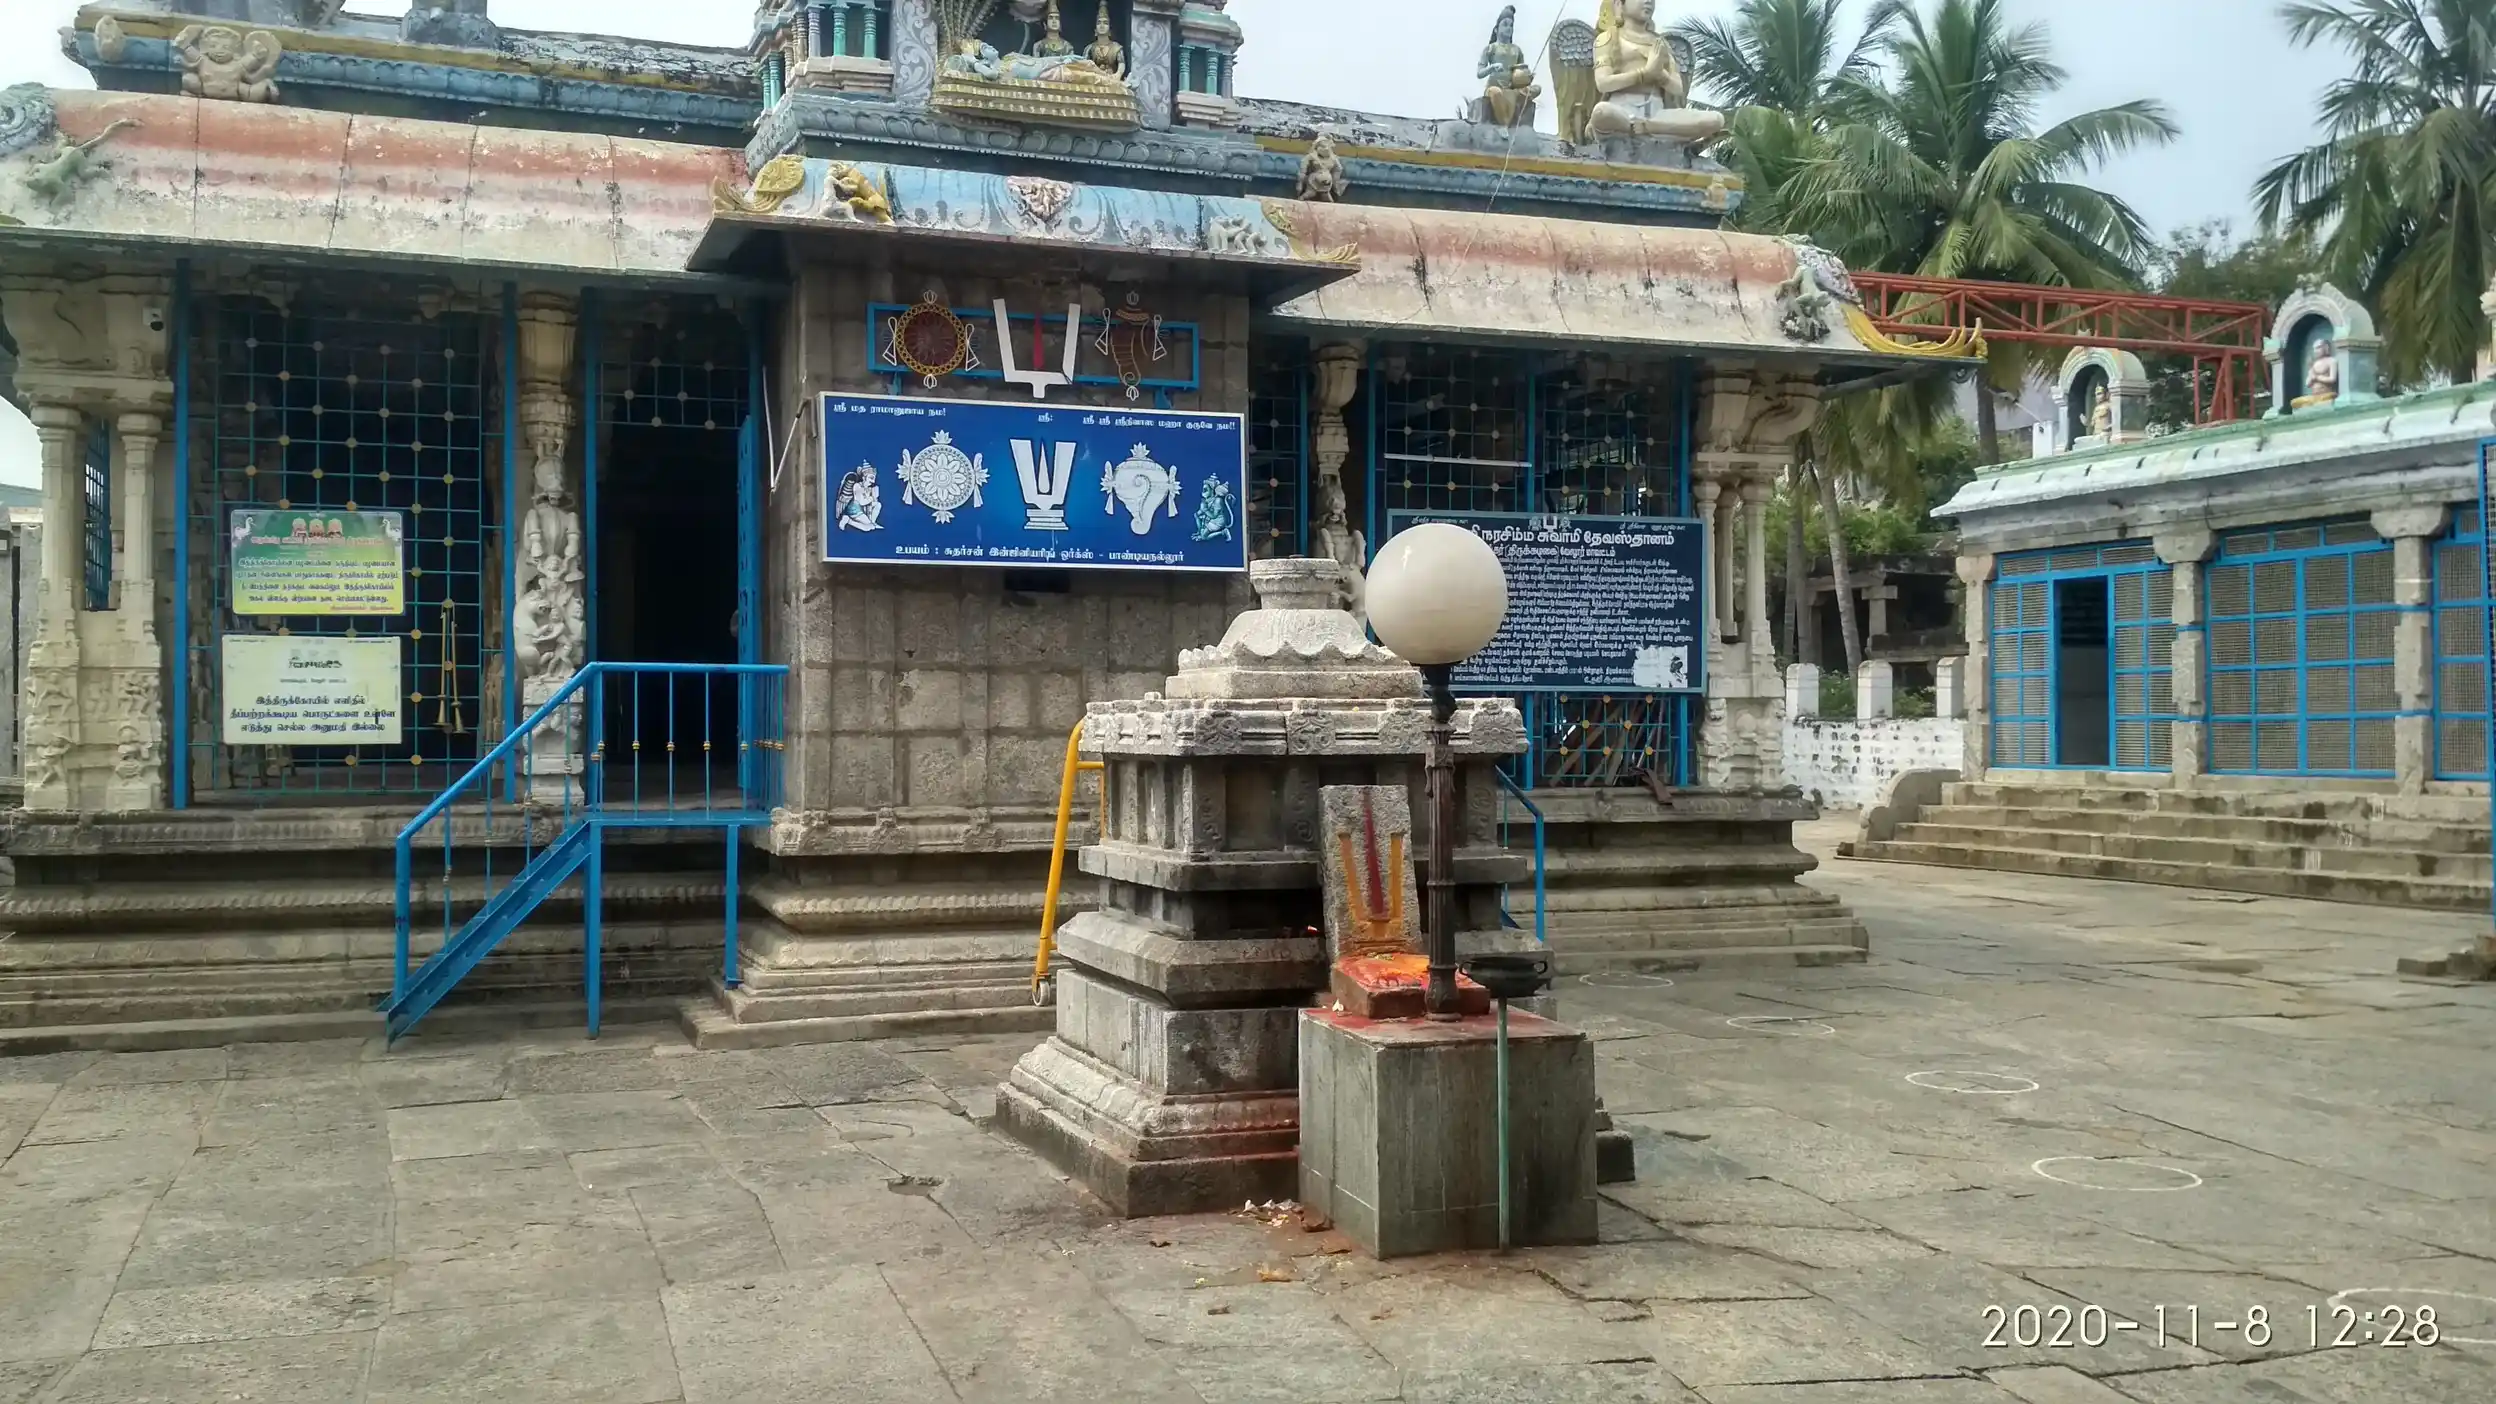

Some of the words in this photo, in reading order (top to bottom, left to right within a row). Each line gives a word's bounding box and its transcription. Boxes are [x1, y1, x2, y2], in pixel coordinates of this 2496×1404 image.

[1537, 528, 1582, 543] சுவாமி
[1584, 530, 1674, 548] தேவஸ்தானம்
[895, 543, 930, 555] உபயம்
